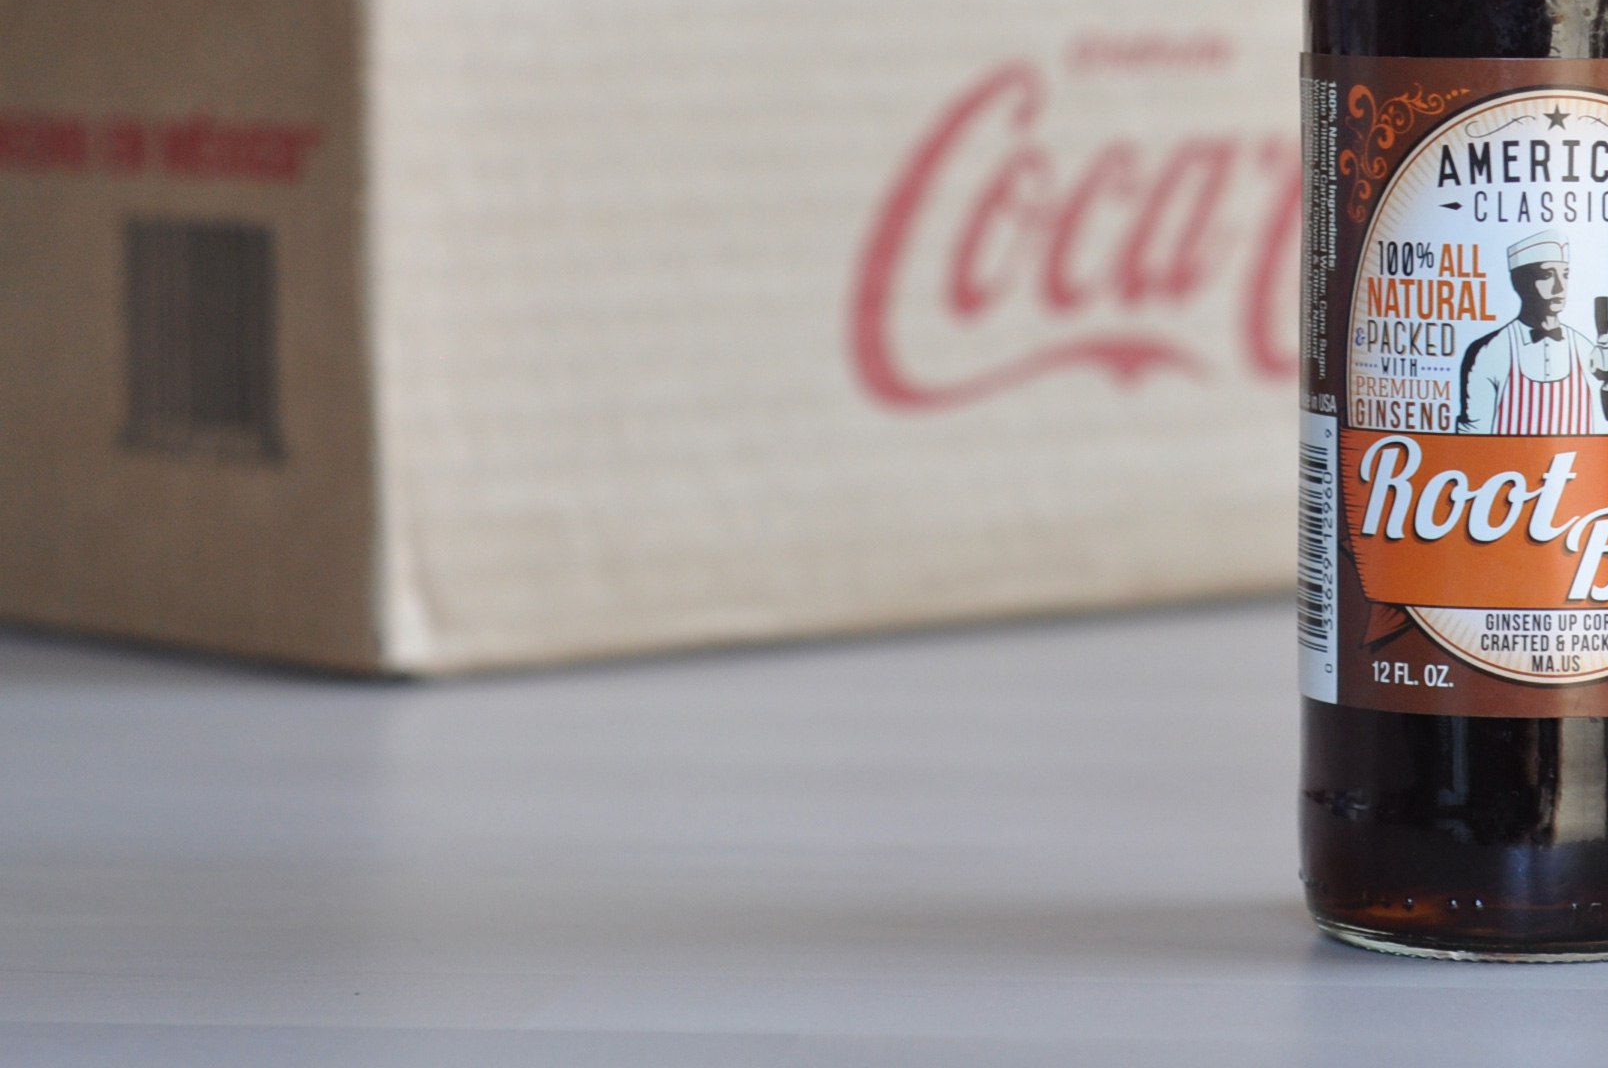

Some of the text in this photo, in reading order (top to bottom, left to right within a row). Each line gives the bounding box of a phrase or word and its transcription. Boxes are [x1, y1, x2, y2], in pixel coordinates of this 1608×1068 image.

[1328, 81, 1337, 122] 100%
[1328, 126, 1337, 180] Natural
[1377, 241, 1487, 278] 100% ALL
[1366, 276, 1497, 321] NATURAL
[1367, 319, 1456, 357] PACKED
[1380, 357, 1418, 377] WITH
[1318, 392, 1338, 414] USA
[1355, 376, 1450, 401] PREMIUM
[1355, 398, 1450, 431] GINSENG
[1323, 471, 1333, 540] 12960
[1359, 435, 1580, 542] Root
[1323, 557, 1333, 630] 33629
[1485, 613, 1552, 631] GINSENG
[1558, 613, 1578, 631] UP
[1480, 633, 1549, 652] CRAFTED
[1556, 634, 1566, 652] &
[1372, 660, 1455, 688] 12 FL. OZ.
[1531, 654, 1581, 673] MA.US
